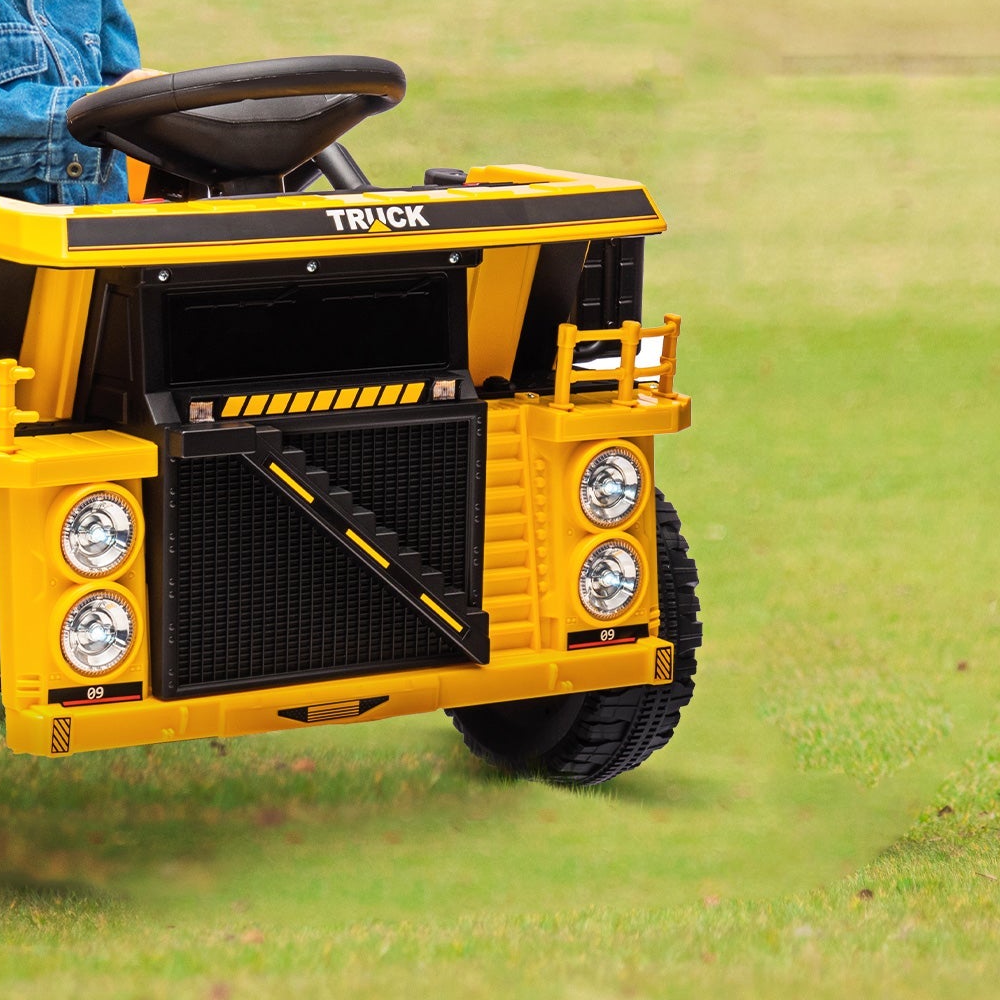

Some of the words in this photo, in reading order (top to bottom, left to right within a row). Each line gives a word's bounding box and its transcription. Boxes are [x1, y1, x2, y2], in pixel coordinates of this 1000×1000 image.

[325, 205, 430, 231] TRUCK
[600, 628, 615, 641] 09
[87, 686, 104, 700] 09
